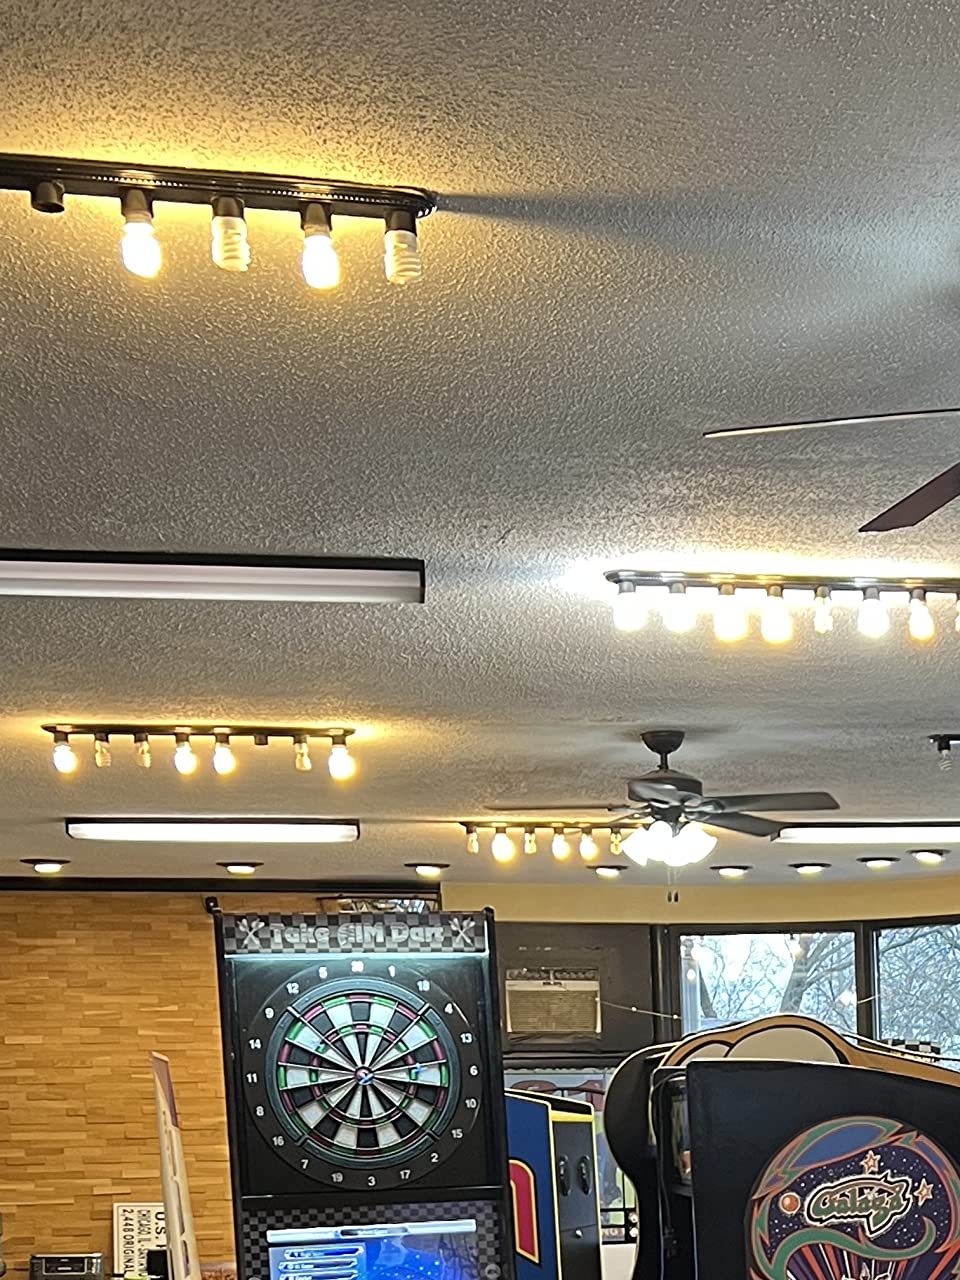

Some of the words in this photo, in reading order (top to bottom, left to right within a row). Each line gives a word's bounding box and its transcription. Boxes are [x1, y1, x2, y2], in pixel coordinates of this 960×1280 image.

[270, 922, 330, 944] Take
[390, 921, 445, 943] Dart
[461, 1033, 473, 1044] 13
[249, 1039, 261, 1049] 14
[470, 1066, 478, 1076] 6
[247, 1074, 258, 1083] 11
[466, 1099, 477, 1109] 10
[257, 1106, 265, 1117] 8
[452, 1129, 463, 1139] 15
[273, 1136, 285, 1146] 16
[431, 1153, 439, 1163] 2
[302, 1160, 309, 1169] 7
[332, 1173, 343, 1183] 19
[400, 1170, 411, 1179] 17
[368, 1177, 376, 1186] 3
[121, 1209, 135, 1233] 2,448
[123, 1234, 135, 1273] ORIGINAL
